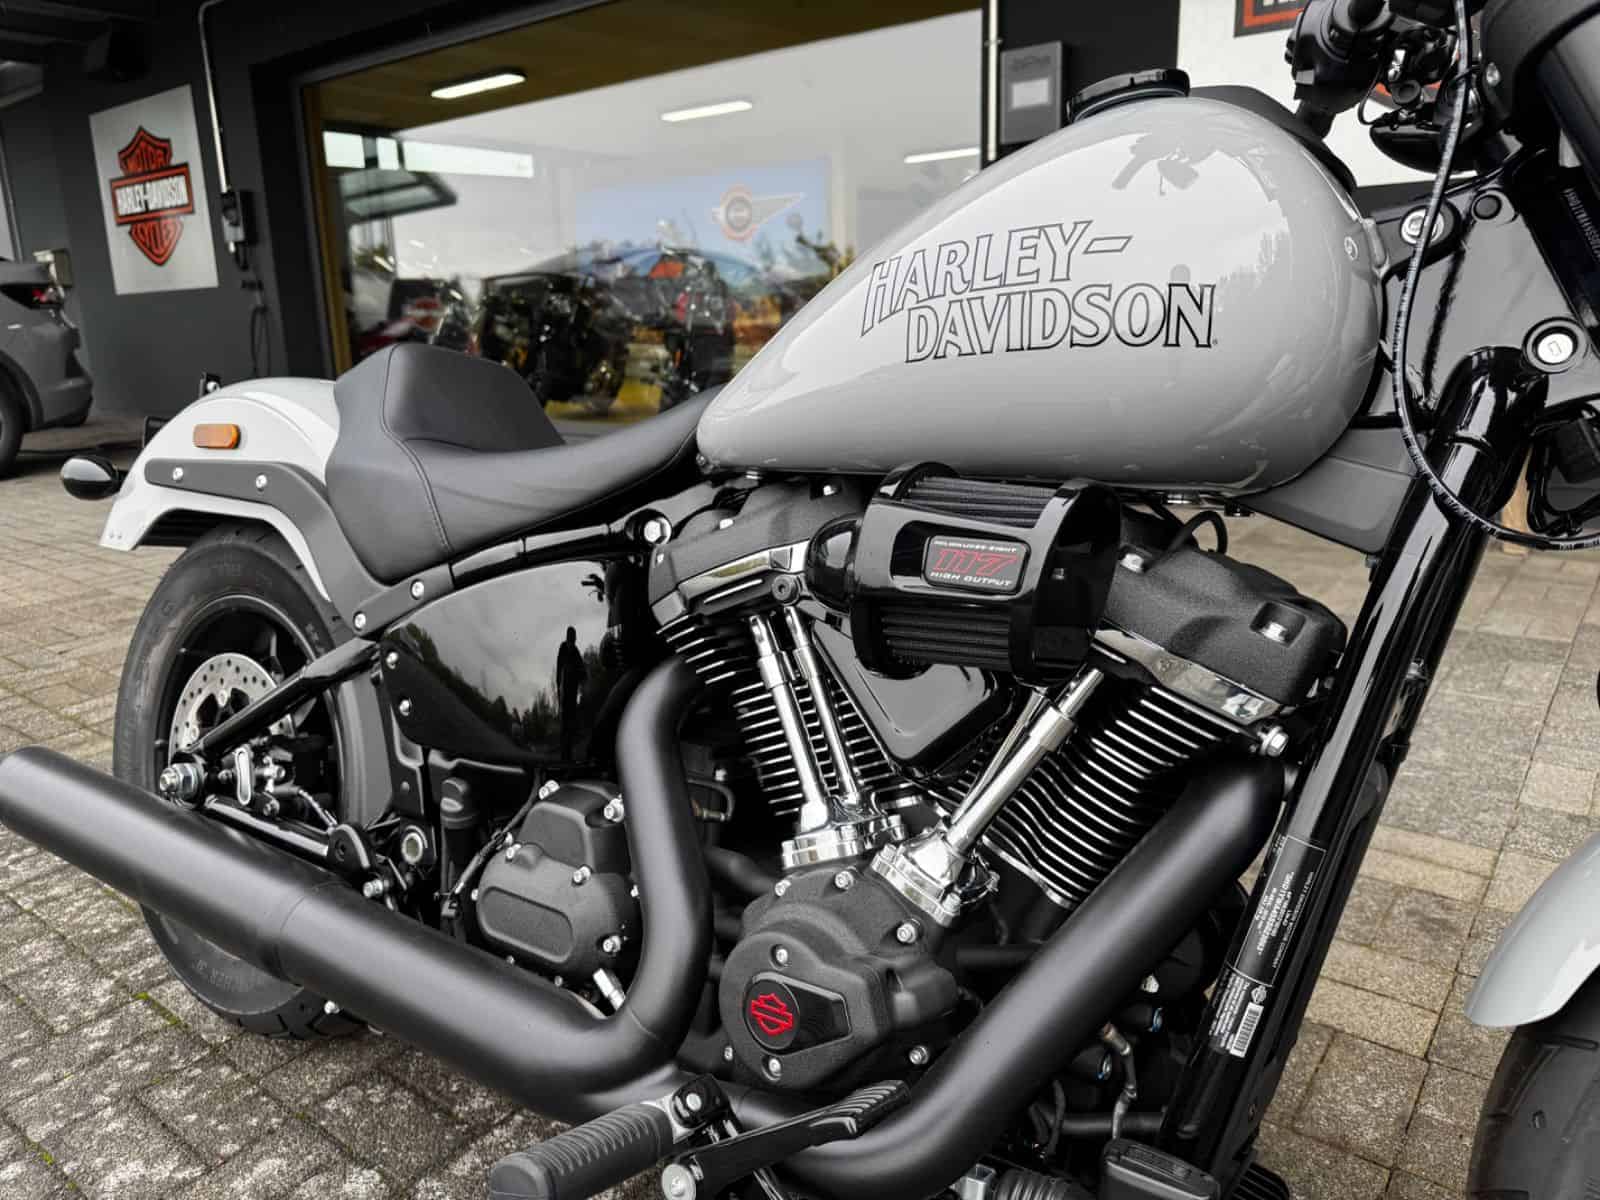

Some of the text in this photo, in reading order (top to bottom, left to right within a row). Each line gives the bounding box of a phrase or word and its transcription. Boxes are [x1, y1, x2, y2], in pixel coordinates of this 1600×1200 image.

[115, 174, 188, 216] HARLEY-DAVIDSON
[861, 220, 1133, 337] HARLEY-
[905, 283, 1216, 363] DAVIDSON
[930, 571, 1013, 587] HIGH OUTPUT
